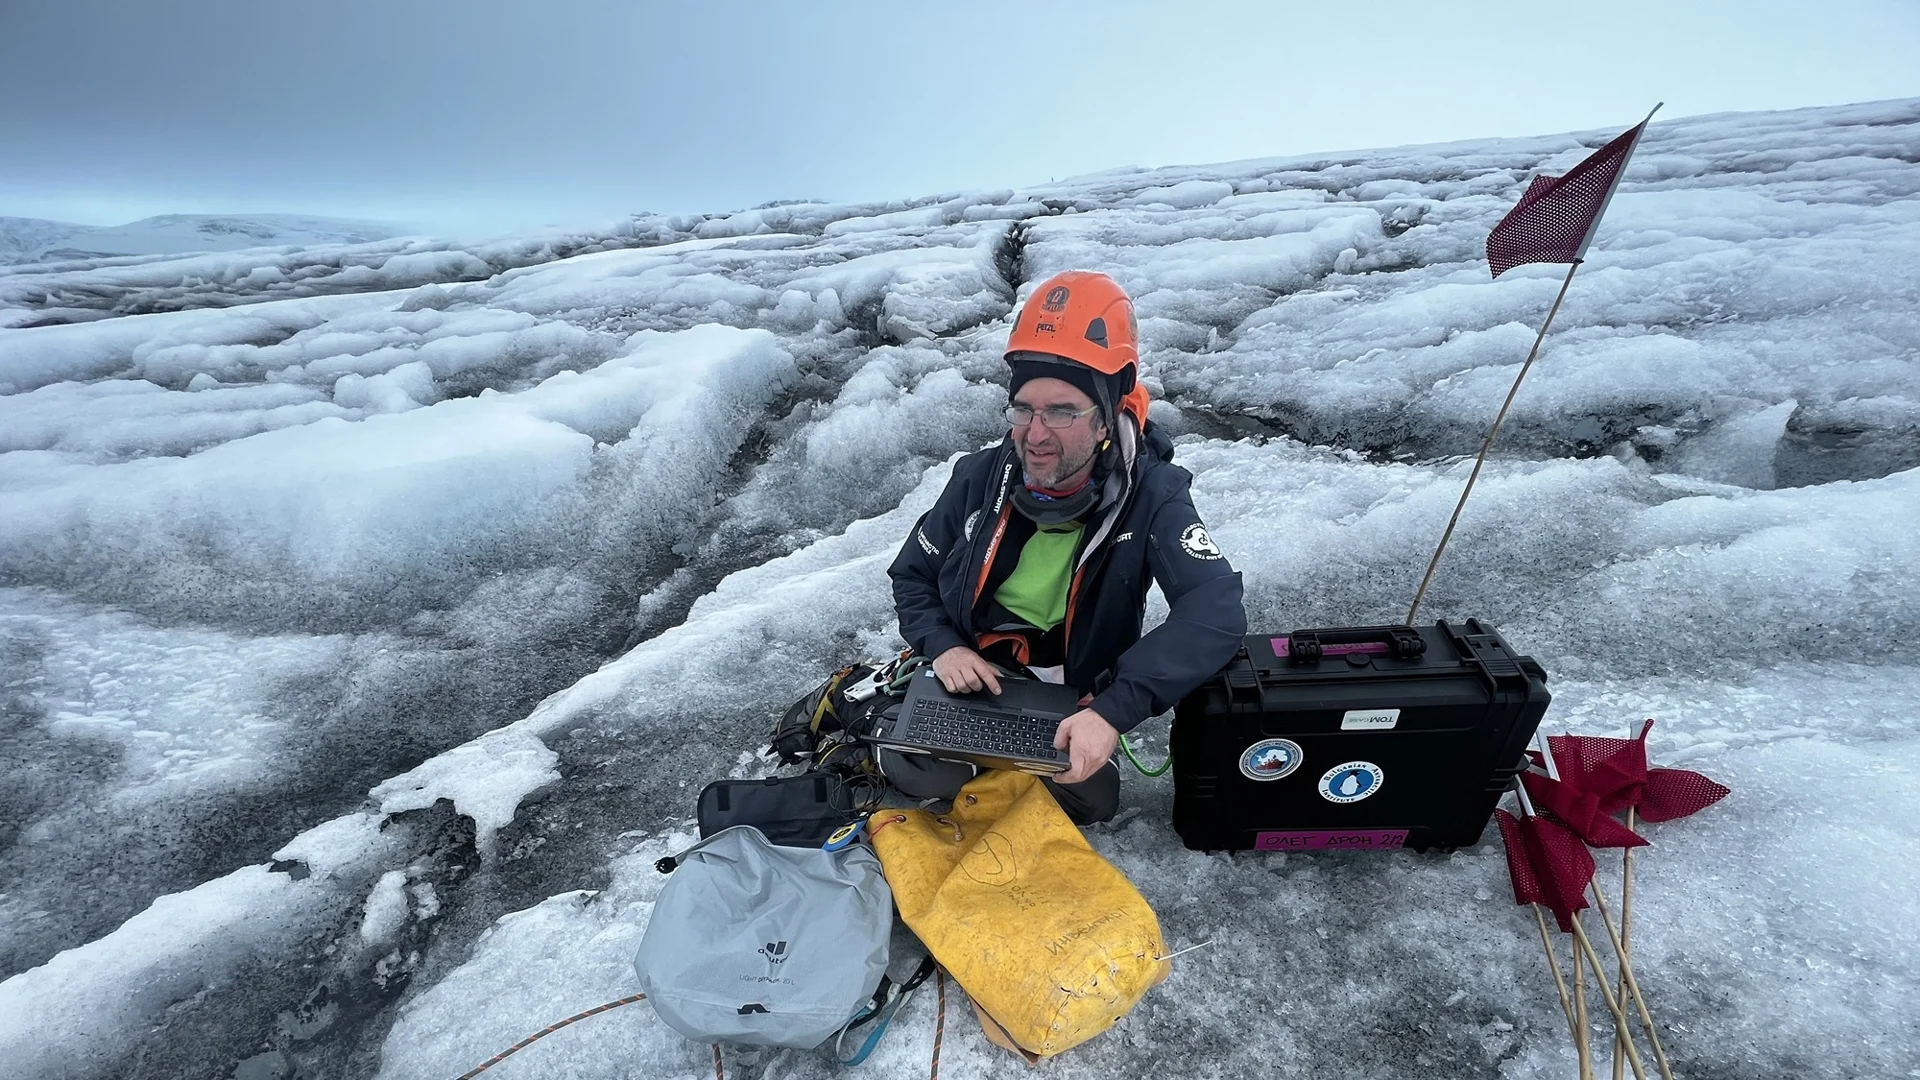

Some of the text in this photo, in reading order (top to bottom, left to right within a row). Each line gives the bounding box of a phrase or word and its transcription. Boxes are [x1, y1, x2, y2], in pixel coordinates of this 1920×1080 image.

[1116, 532, 1133, 542] ORT
[1266, 834, 1404, 847] ОЛЕГ ДРОН 2/2
